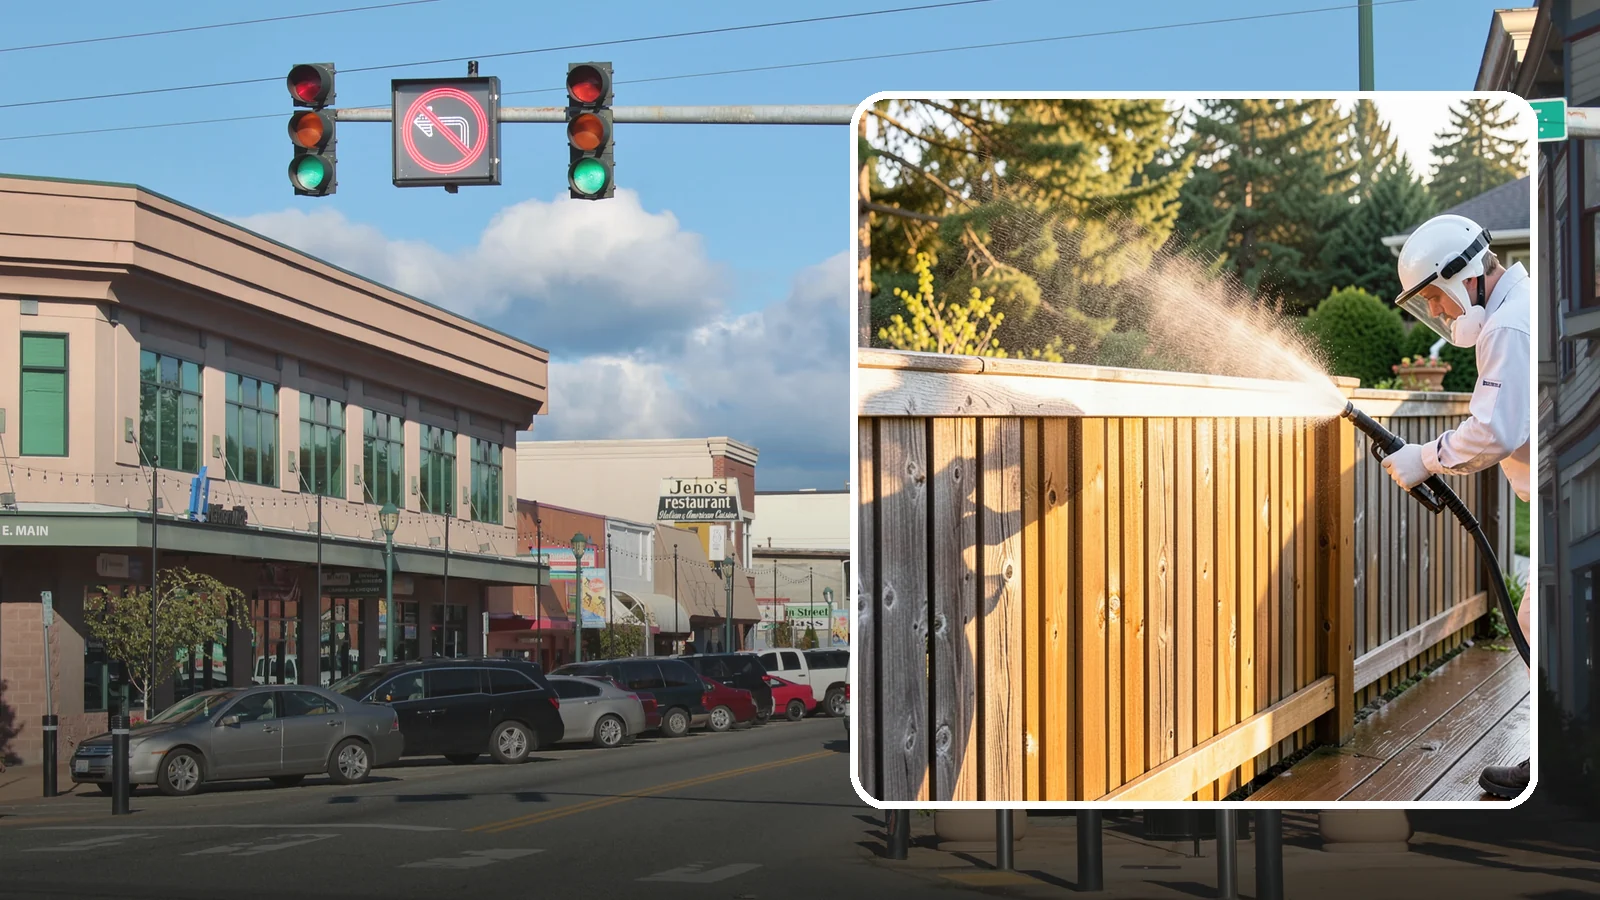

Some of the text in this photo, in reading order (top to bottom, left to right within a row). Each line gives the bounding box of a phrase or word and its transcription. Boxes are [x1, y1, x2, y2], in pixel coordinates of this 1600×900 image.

[669, 479, 727, 495] Jeno's
[665, 496, 731, 509] restaurant
[658, 510, 682, 520] Italian
[686, 509, 715, 519] American
[715, 509, 738, 519] Cuisine
[2, 525, 49, 536] E. MAIN
[797, 607, 829, 617] Street
